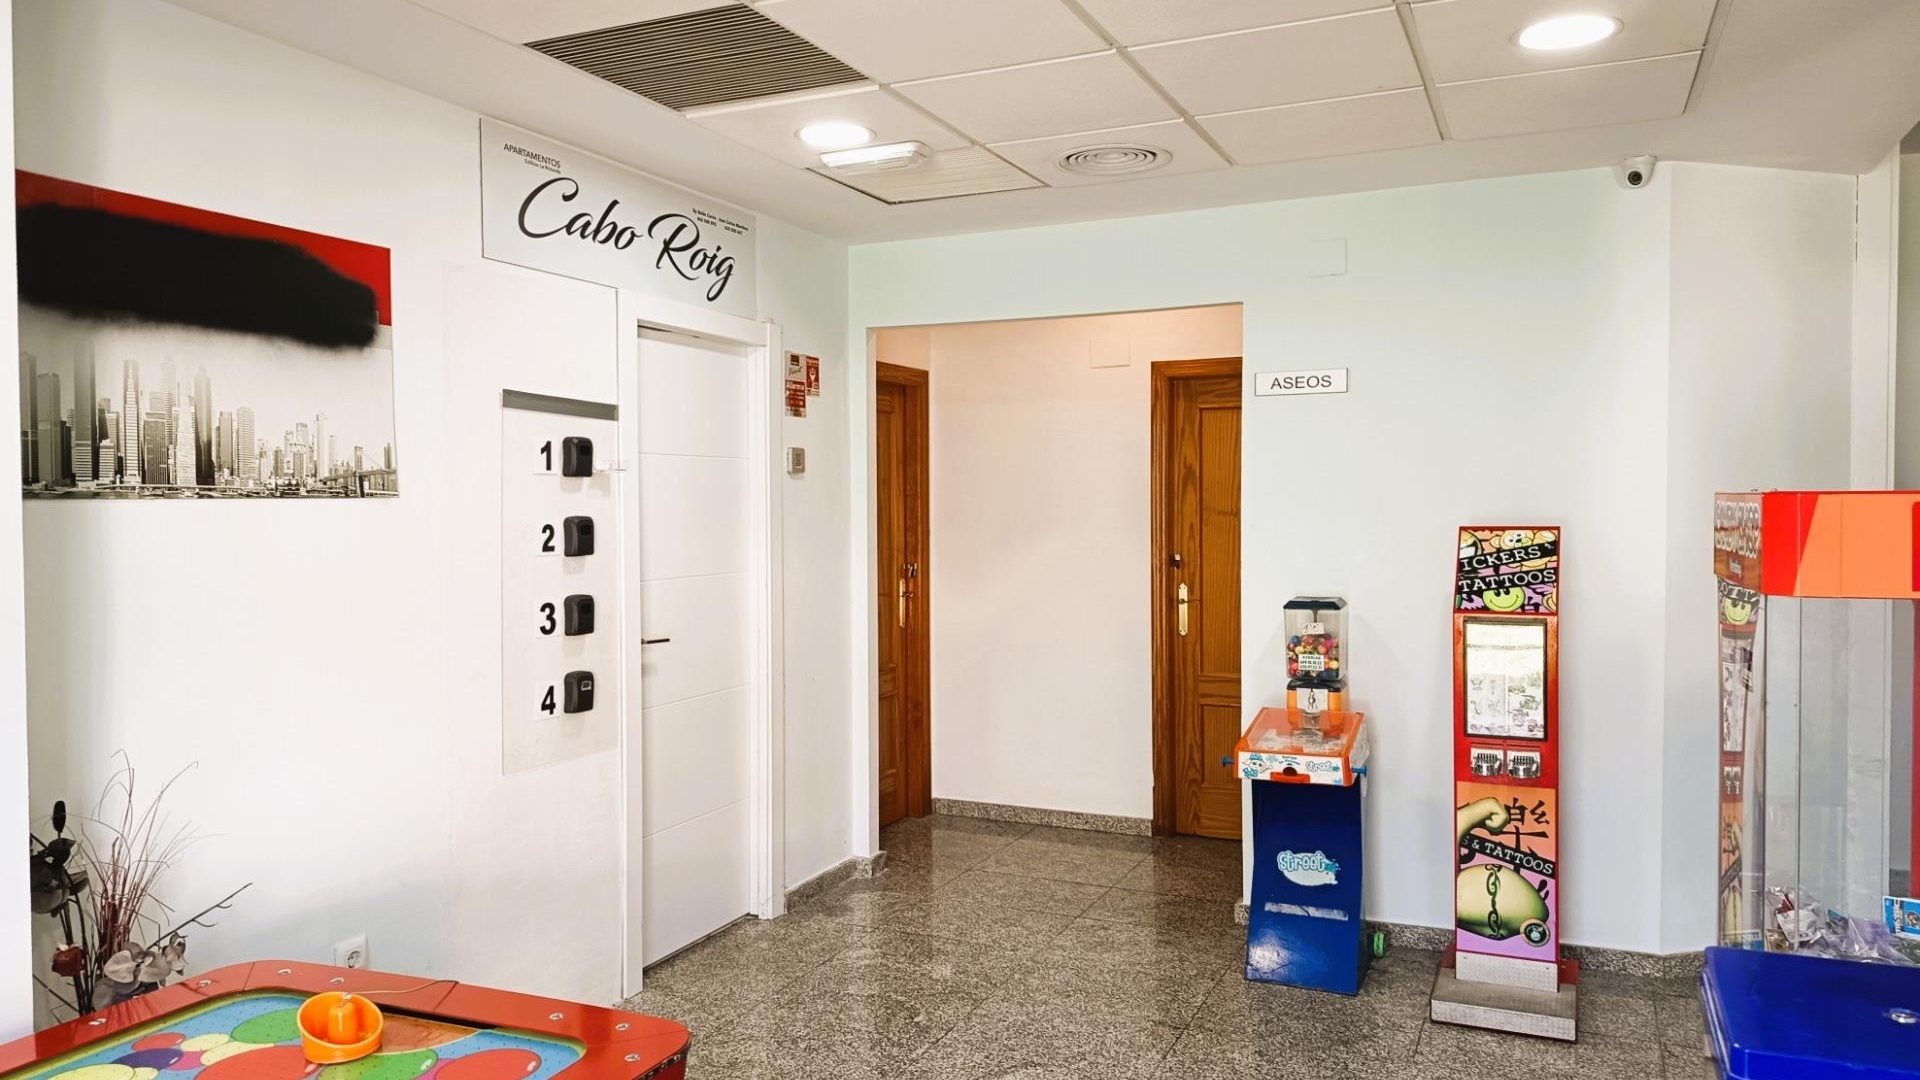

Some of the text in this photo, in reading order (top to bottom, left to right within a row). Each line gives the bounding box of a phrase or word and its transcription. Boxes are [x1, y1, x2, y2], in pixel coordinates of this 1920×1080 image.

[504, 143, 561, 169] APARTAMENTOS
[518, 177, 736, 301] Cabo Roig
[1270, 374, 1332, 390] ASEOS
[540, 440, 552, 471] 1
[541, 524, 555, 552] 2
[1459, 569, 1556, 592] TATTOOS
[539, 602, 556, 635] 3
[540, 685, 556, 715] 4
[1472, 840, 1480, 850] &
[1484, 842, 1554, 875] TATTOOS
